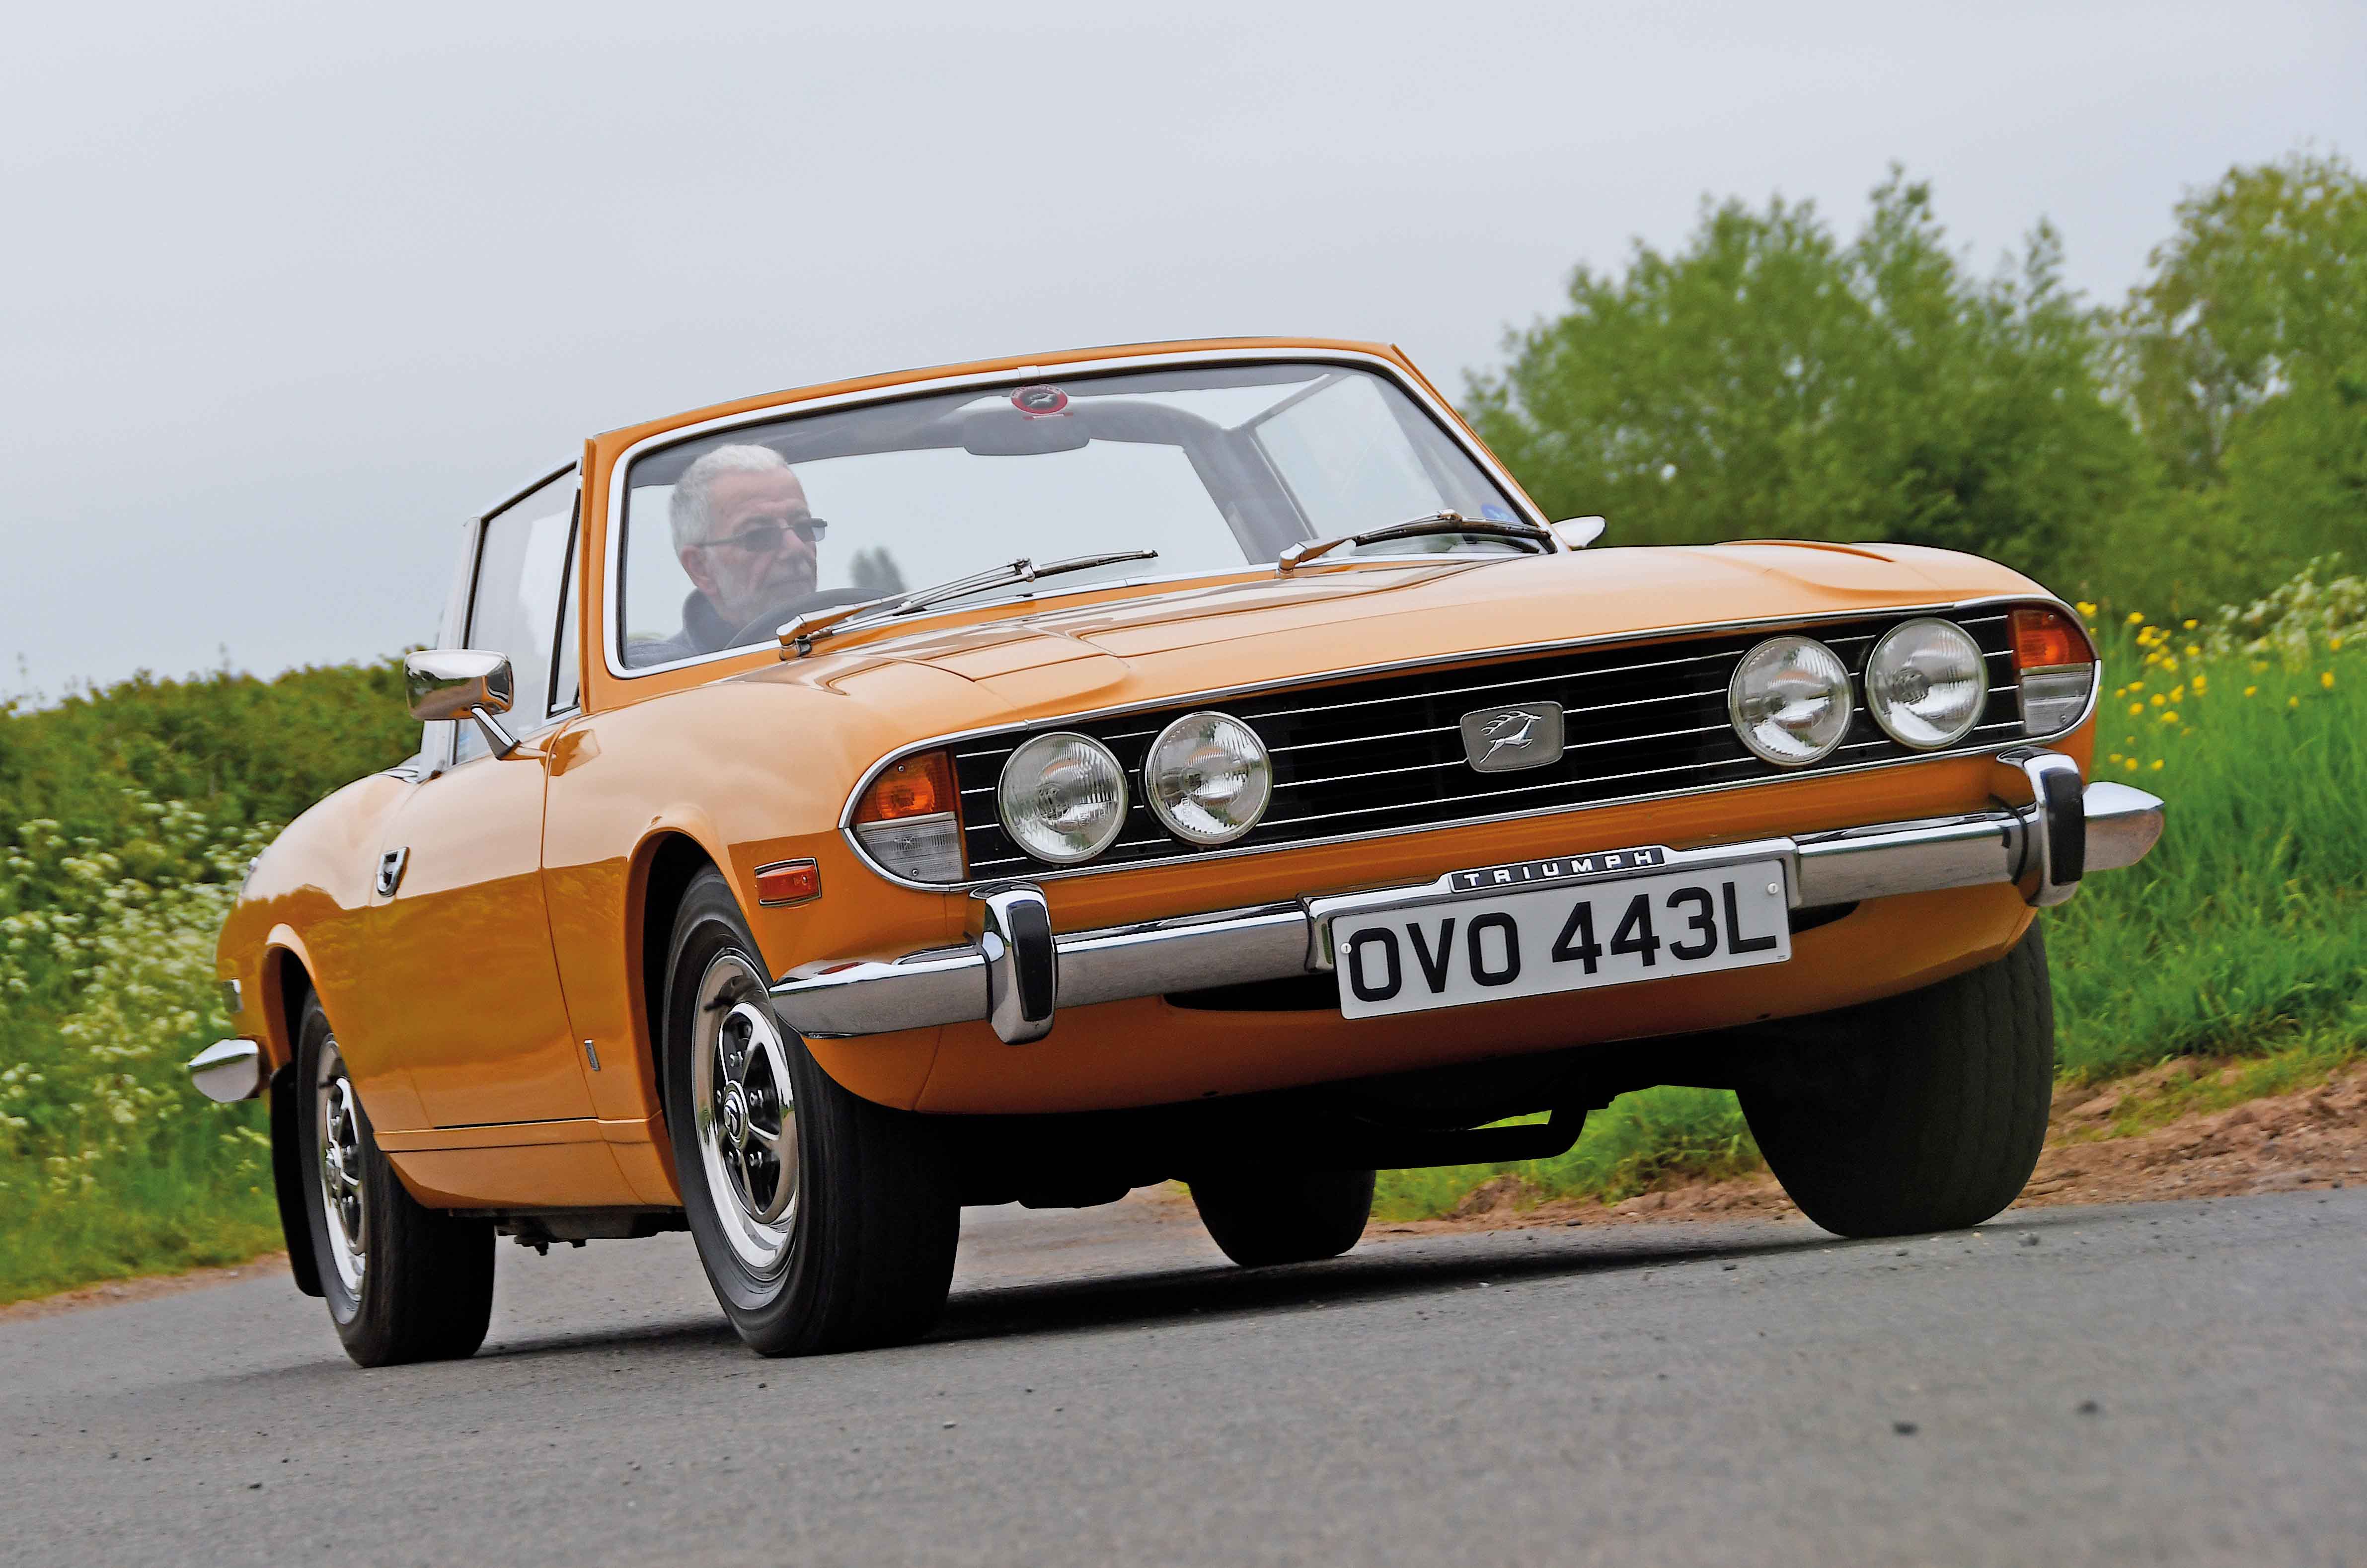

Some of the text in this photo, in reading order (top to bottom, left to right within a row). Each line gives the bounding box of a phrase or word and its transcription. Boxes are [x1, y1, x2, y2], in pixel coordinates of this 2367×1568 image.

[1463, 851, 1653, 887] TRIUMPH
[1348, 882, 1777, 1002] OVO 443L
